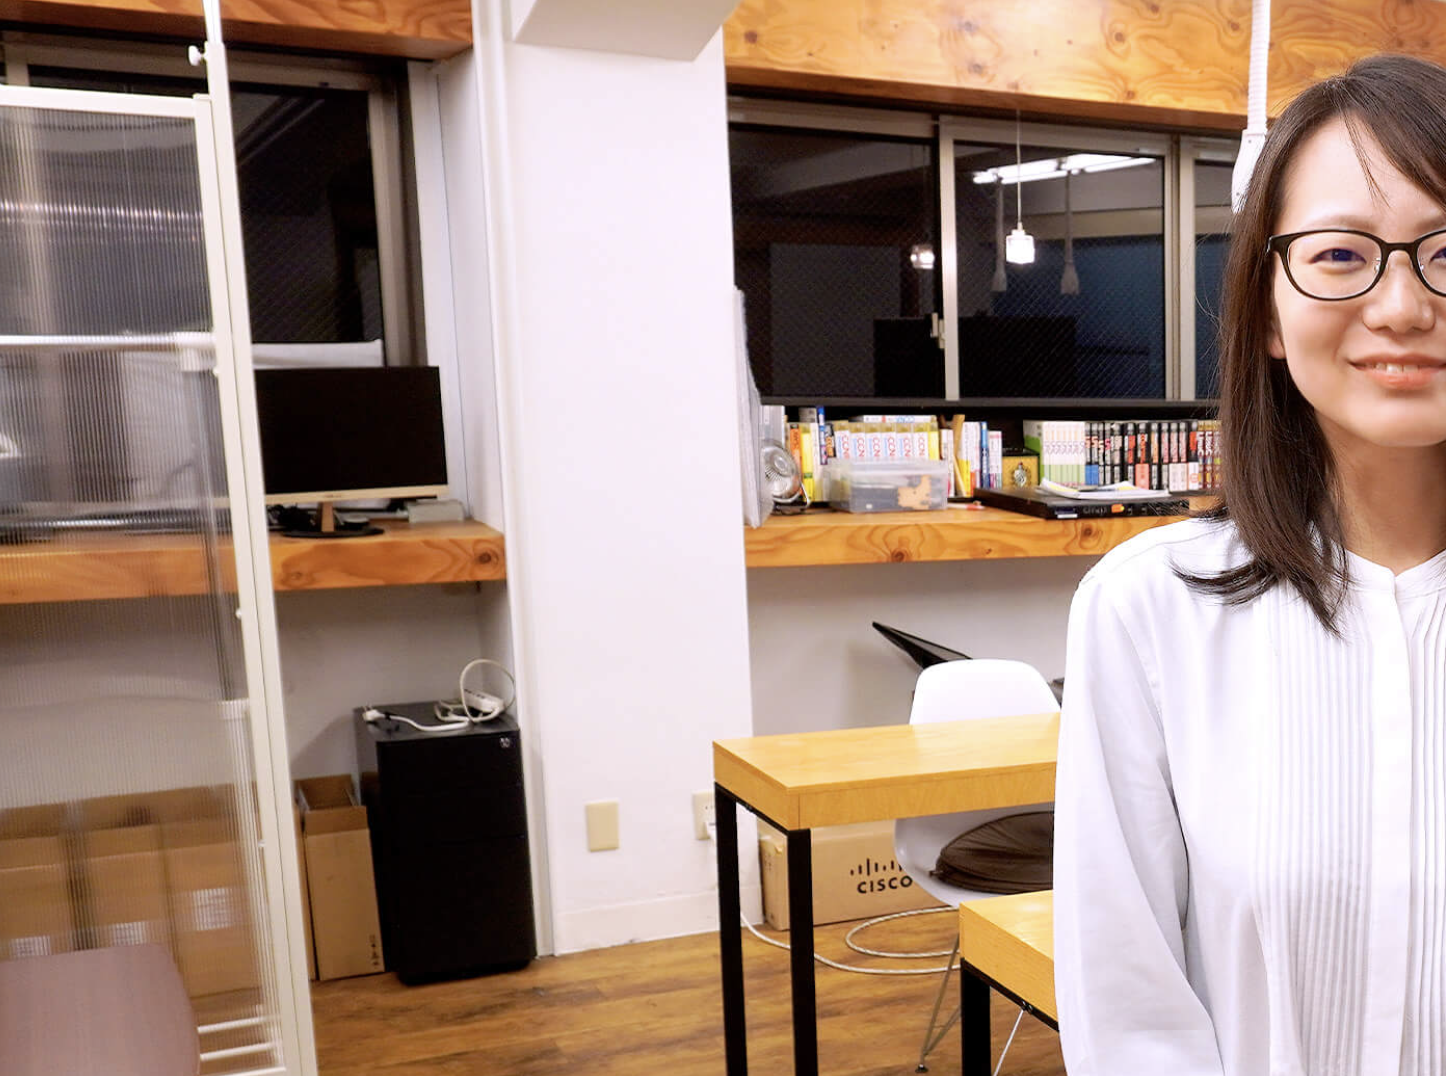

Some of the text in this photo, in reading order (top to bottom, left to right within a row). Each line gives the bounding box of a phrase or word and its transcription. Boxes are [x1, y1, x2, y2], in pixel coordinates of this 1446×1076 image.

[857, 437, 865, 458] CCN
[873, 437, 881, 458] CCN
[888, 437, 896, 457] CCN
[903, 437, 911, 457] CCN
[857, 875, 913, 894] CISCO
